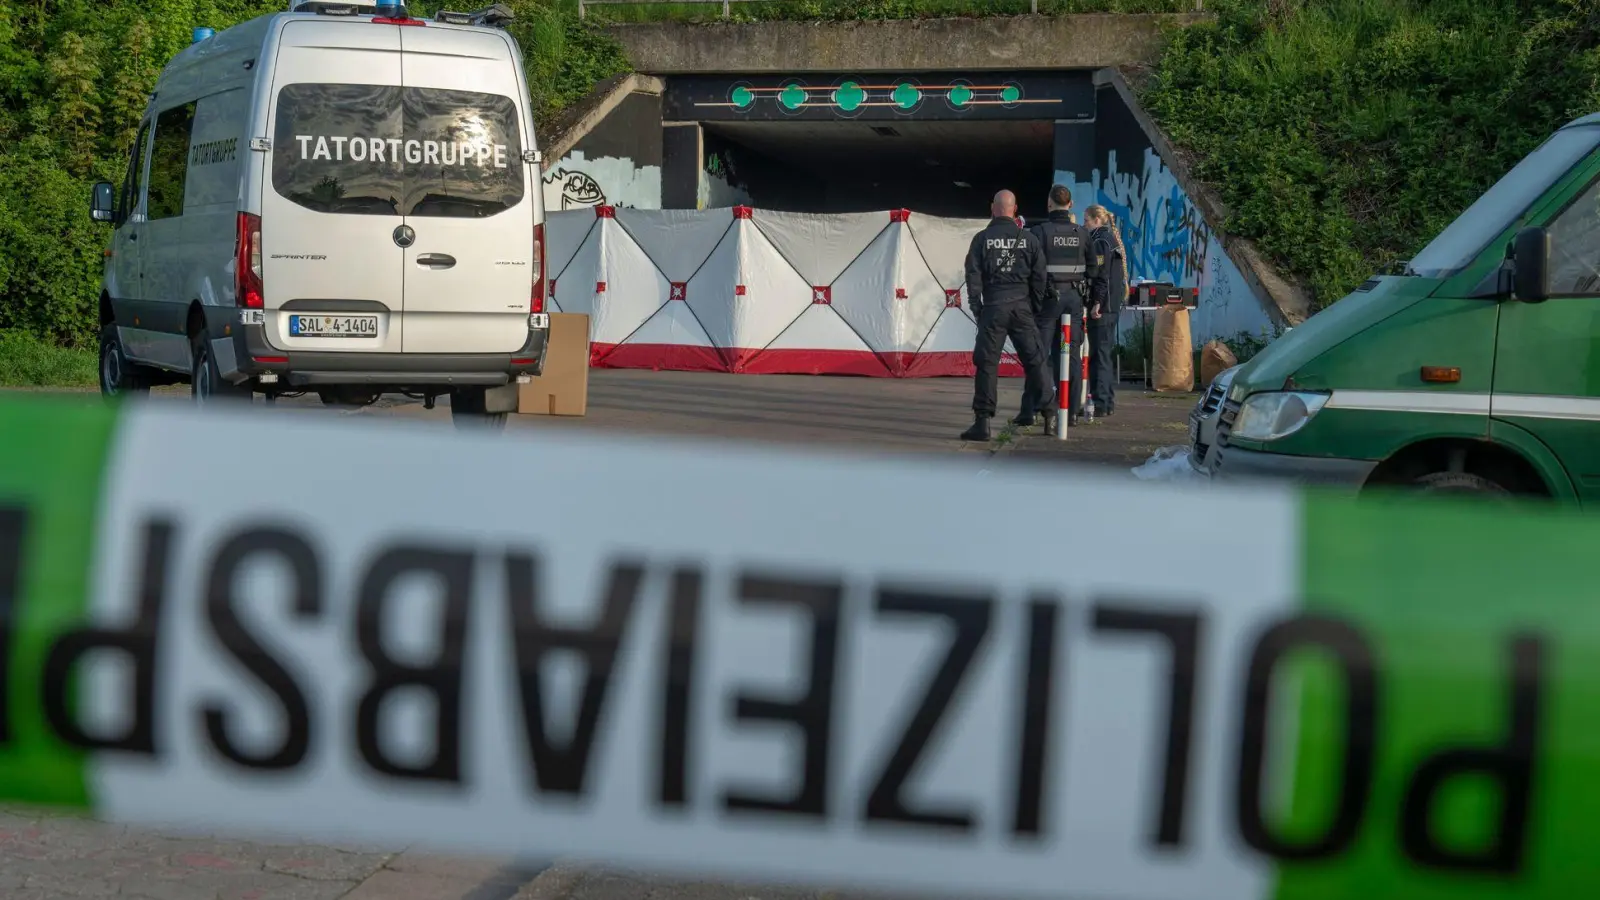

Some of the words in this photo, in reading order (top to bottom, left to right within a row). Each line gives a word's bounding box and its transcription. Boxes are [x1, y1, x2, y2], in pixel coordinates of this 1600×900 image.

[191, 137, 238, 166] TATORTGRUPPE
[296, 135, 507, 168] TATORTGRUPPE
[986, 238, 1027, 249] POLIZEI
[1053, 236, 1080, 247] POLIZEI
[299, 317, 323, 332] SAL
[333, 318, 375, 333] 4-1404
[0, 500, 1550, 878] POLIZEIABSP
